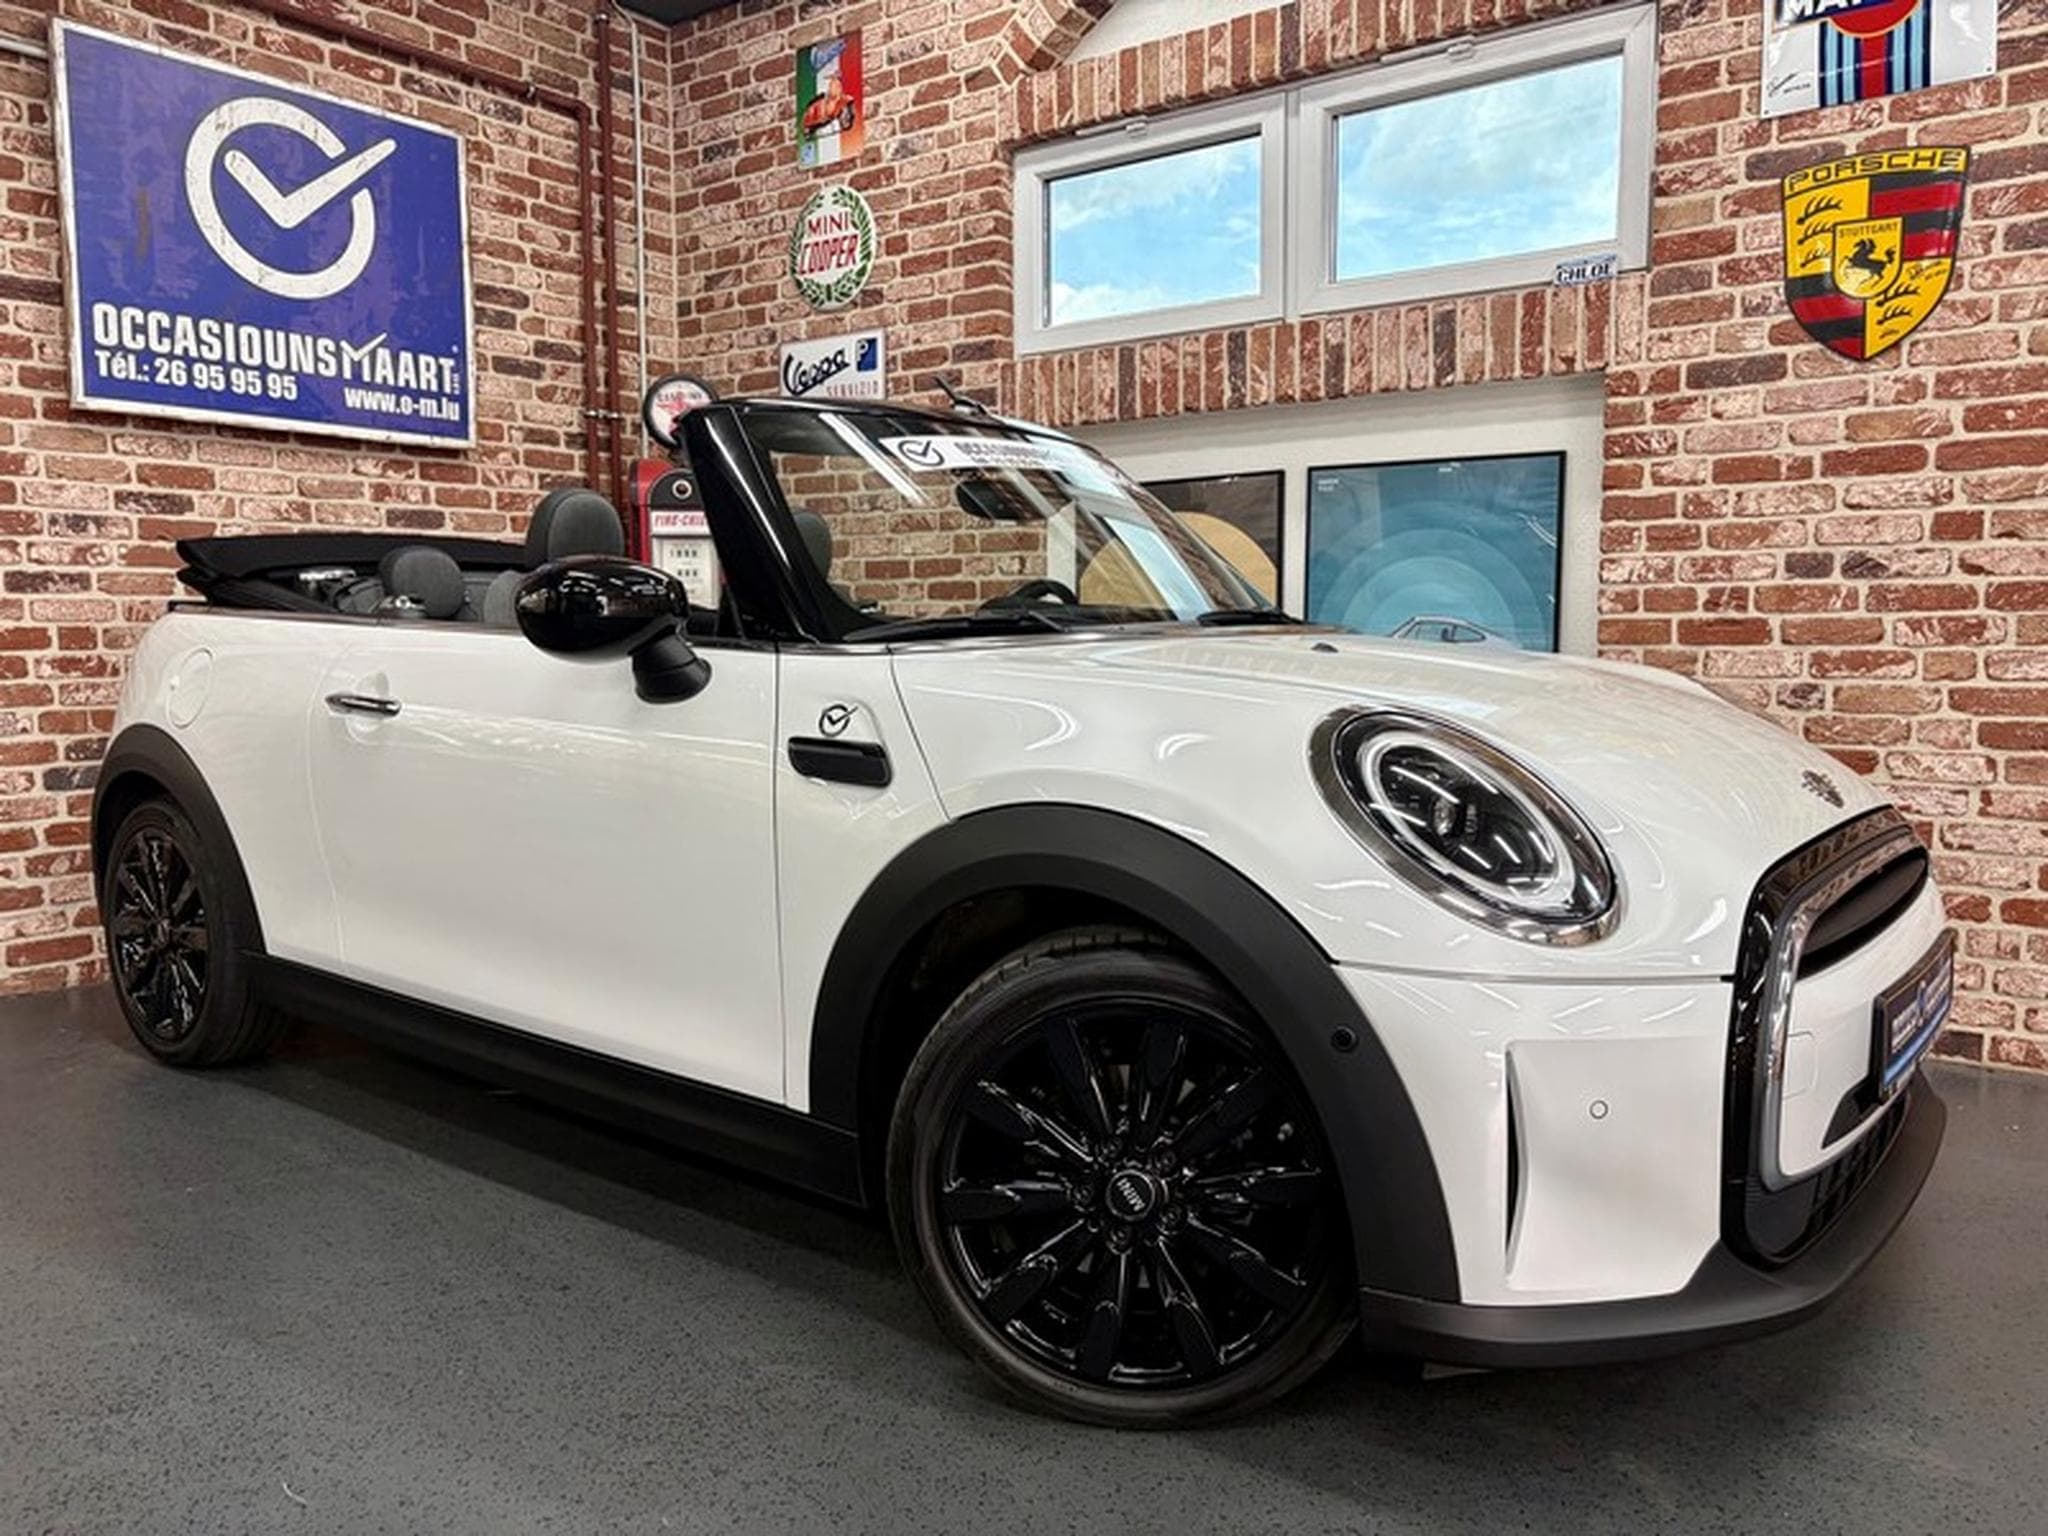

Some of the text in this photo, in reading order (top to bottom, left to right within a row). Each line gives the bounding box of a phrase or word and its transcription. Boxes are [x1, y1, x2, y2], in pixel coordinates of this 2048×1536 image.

[1788, 149, 1962, 193] PORSCHE
[808, 212, 849, 235] MINI
[1839, 222, 1899, 239] STUTTGART
[799, 234, 859, 275] COOPER
[92, 302, 455, 395] OCCASIOUNSMAART
[94, 350, 298, 401] Tél.: 26 95 95 95
[783, 348, 850, 397] Vespa
[826, 380, 879, 398] SERVIZIO
[344, 387, 460, 421] www.o-m.lu
[1117, 1178, 1145, 1211] MINI
